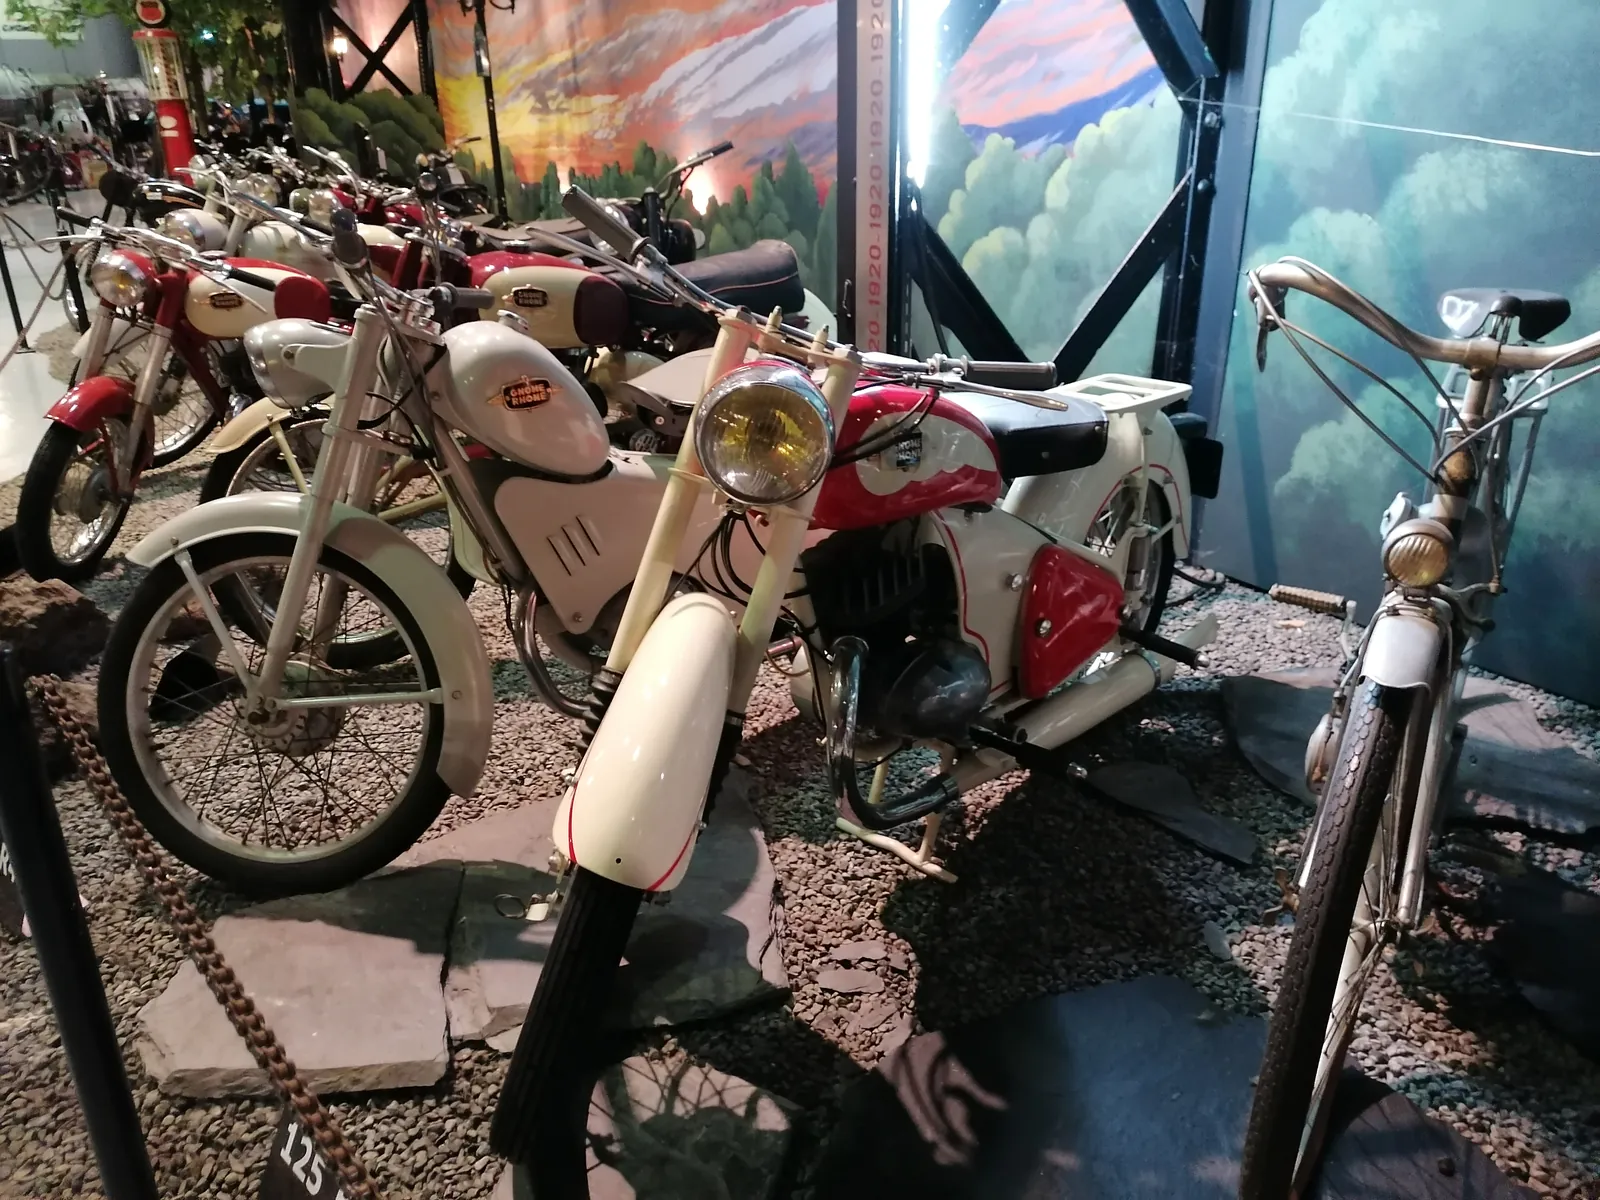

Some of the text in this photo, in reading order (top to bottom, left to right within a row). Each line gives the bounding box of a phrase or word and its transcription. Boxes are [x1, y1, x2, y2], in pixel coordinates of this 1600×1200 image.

[510, 383, 546, 397] GNOME
[511, 392, 547, 406] RHONE
[280, 1122, 326, 1196] 125
